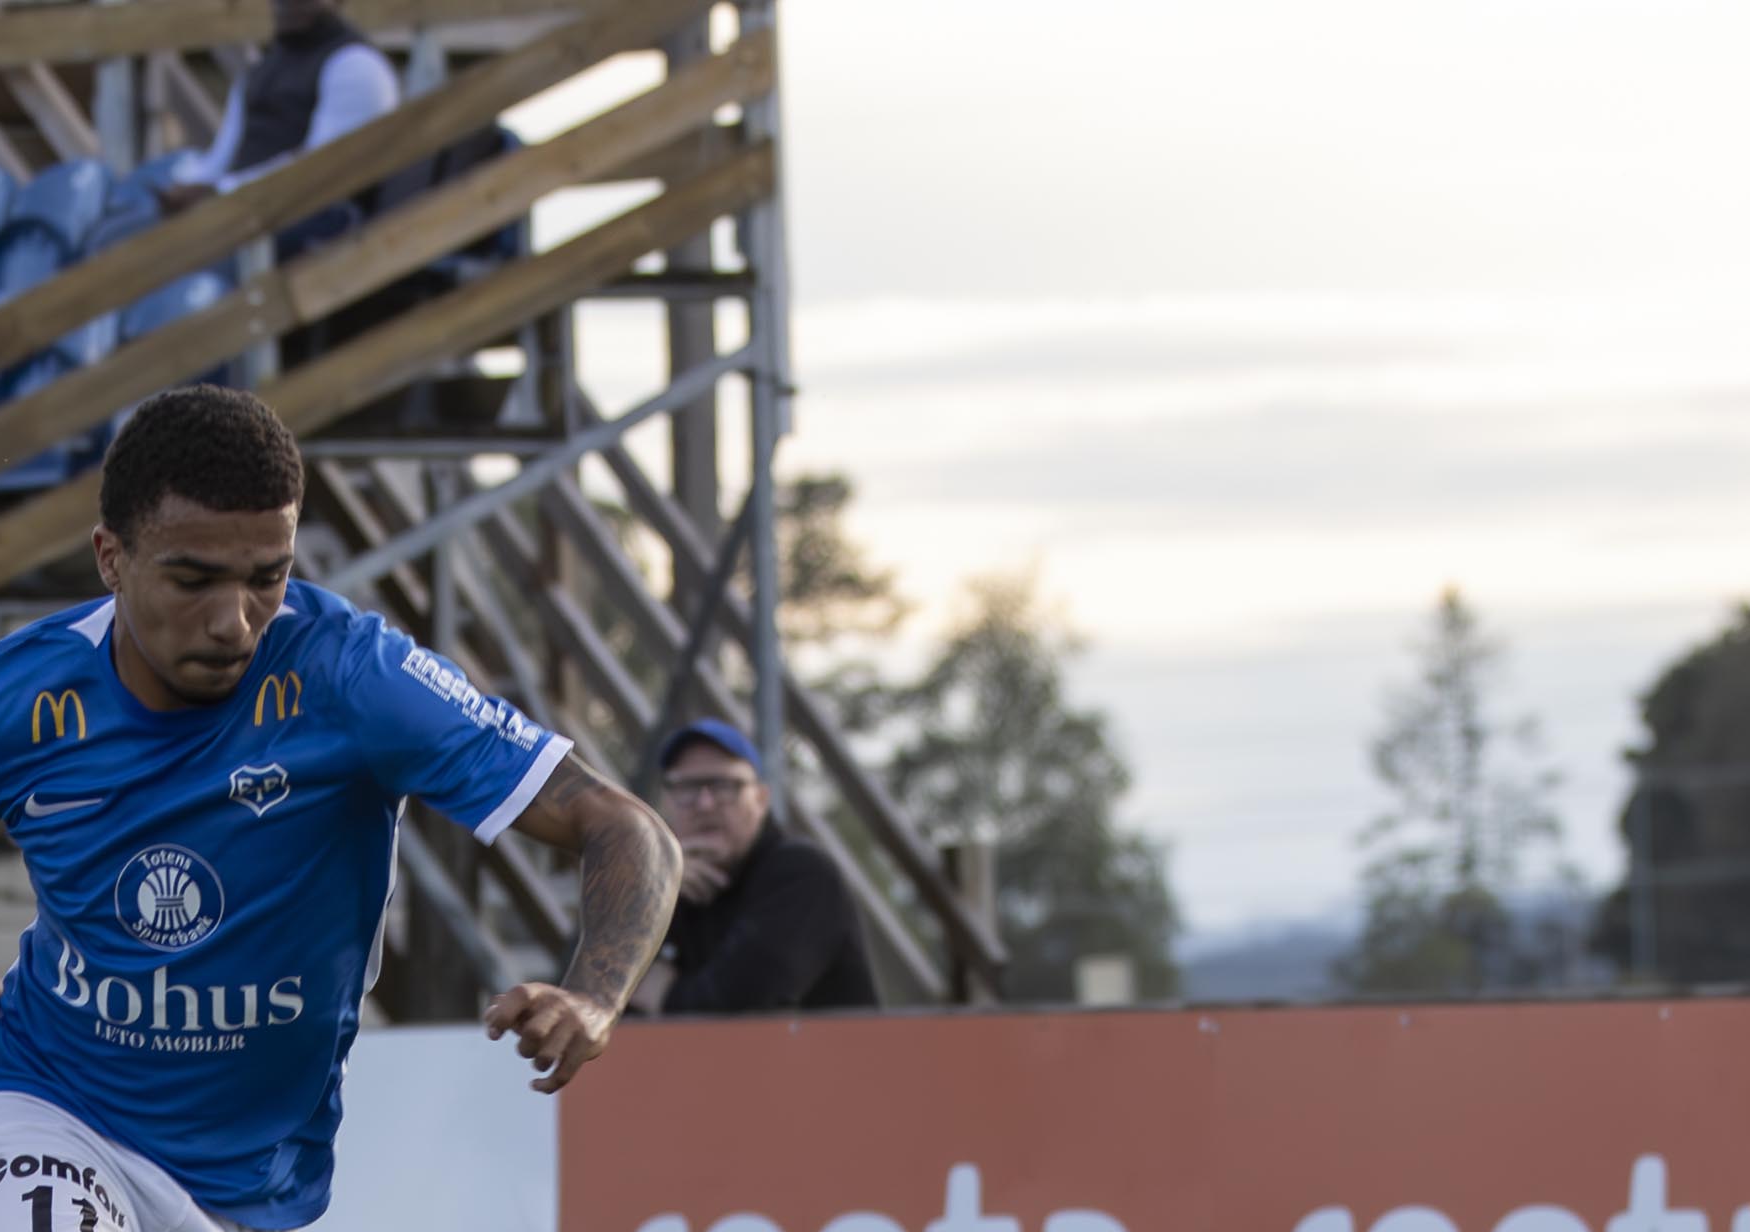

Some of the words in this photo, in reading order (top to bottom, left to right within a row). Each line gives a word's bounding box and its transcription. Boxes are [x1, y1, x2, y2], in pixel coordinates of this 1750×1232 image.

[138, 849, 193, 871] Totens
[132, 913, 214, 947] Sparebank
[51, 937, 304, 1032] Bohus
[95, 1018, 146, 1049] LETO
